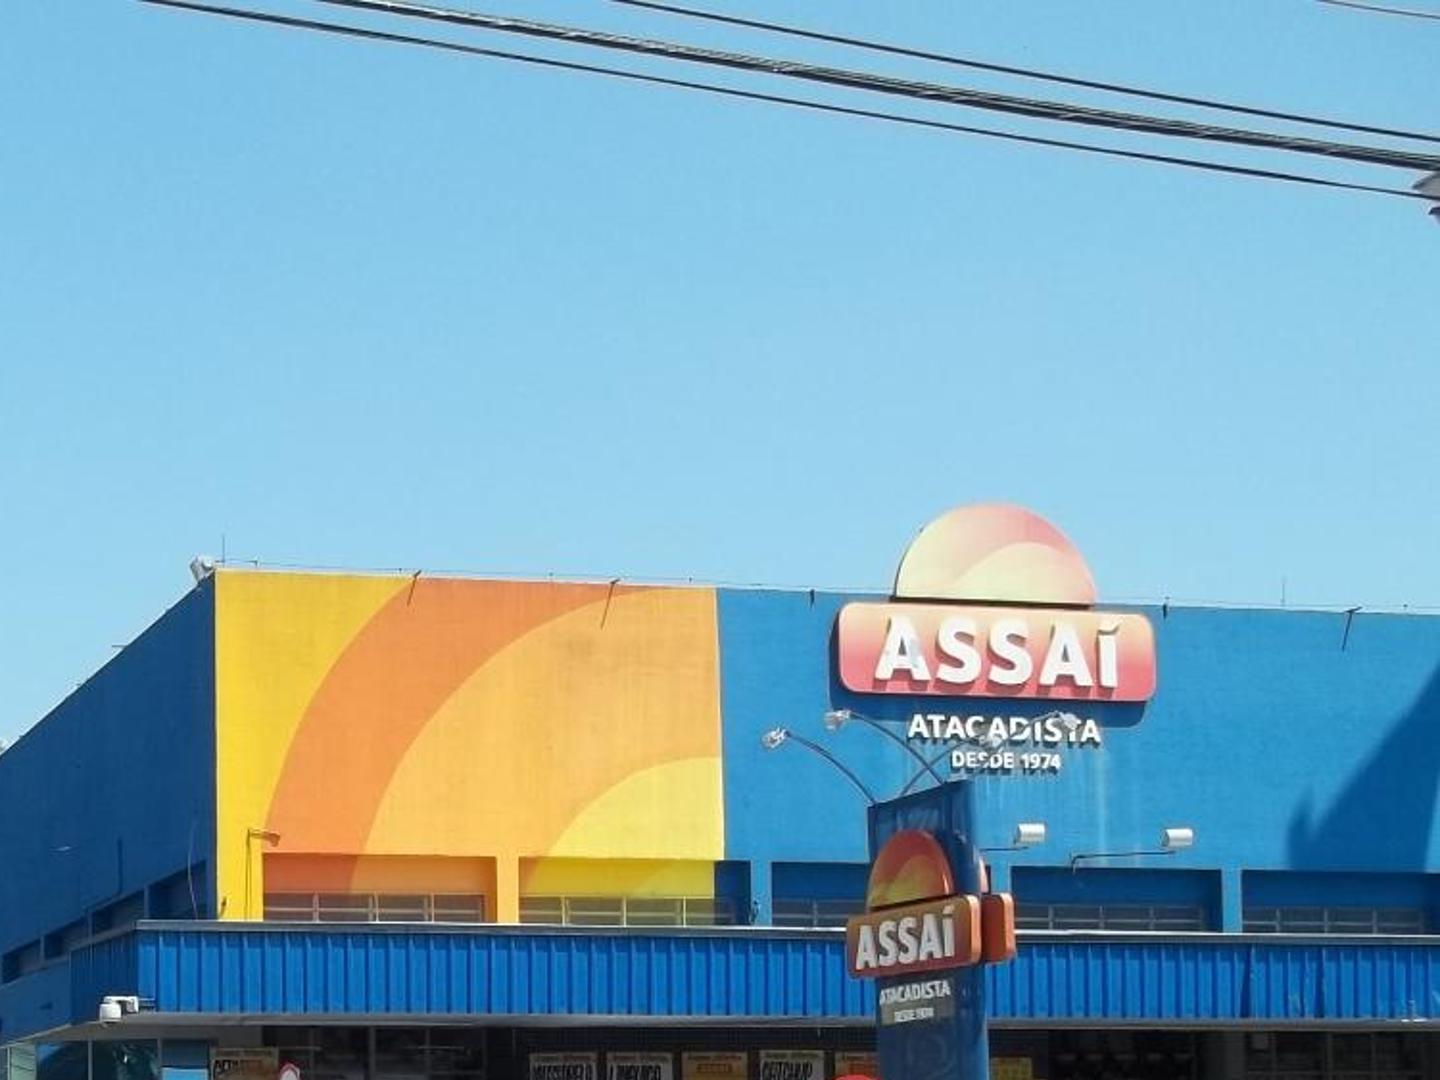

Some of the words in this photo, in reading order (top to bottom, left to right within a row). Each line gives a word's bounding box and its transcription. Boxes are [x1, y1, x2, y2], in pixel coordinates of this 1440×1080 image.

[874, 612, 1121, 688] ASSAÍ
[907, 713, 1102, 743] ATACADISTA
[951, 749, 1014, 769] DESDE
[1021, 753, 1061, 770] 1974
[855, 905, 957, 970] ASSAÍ
[879, 979, 952, 1005] ATACADISTA
